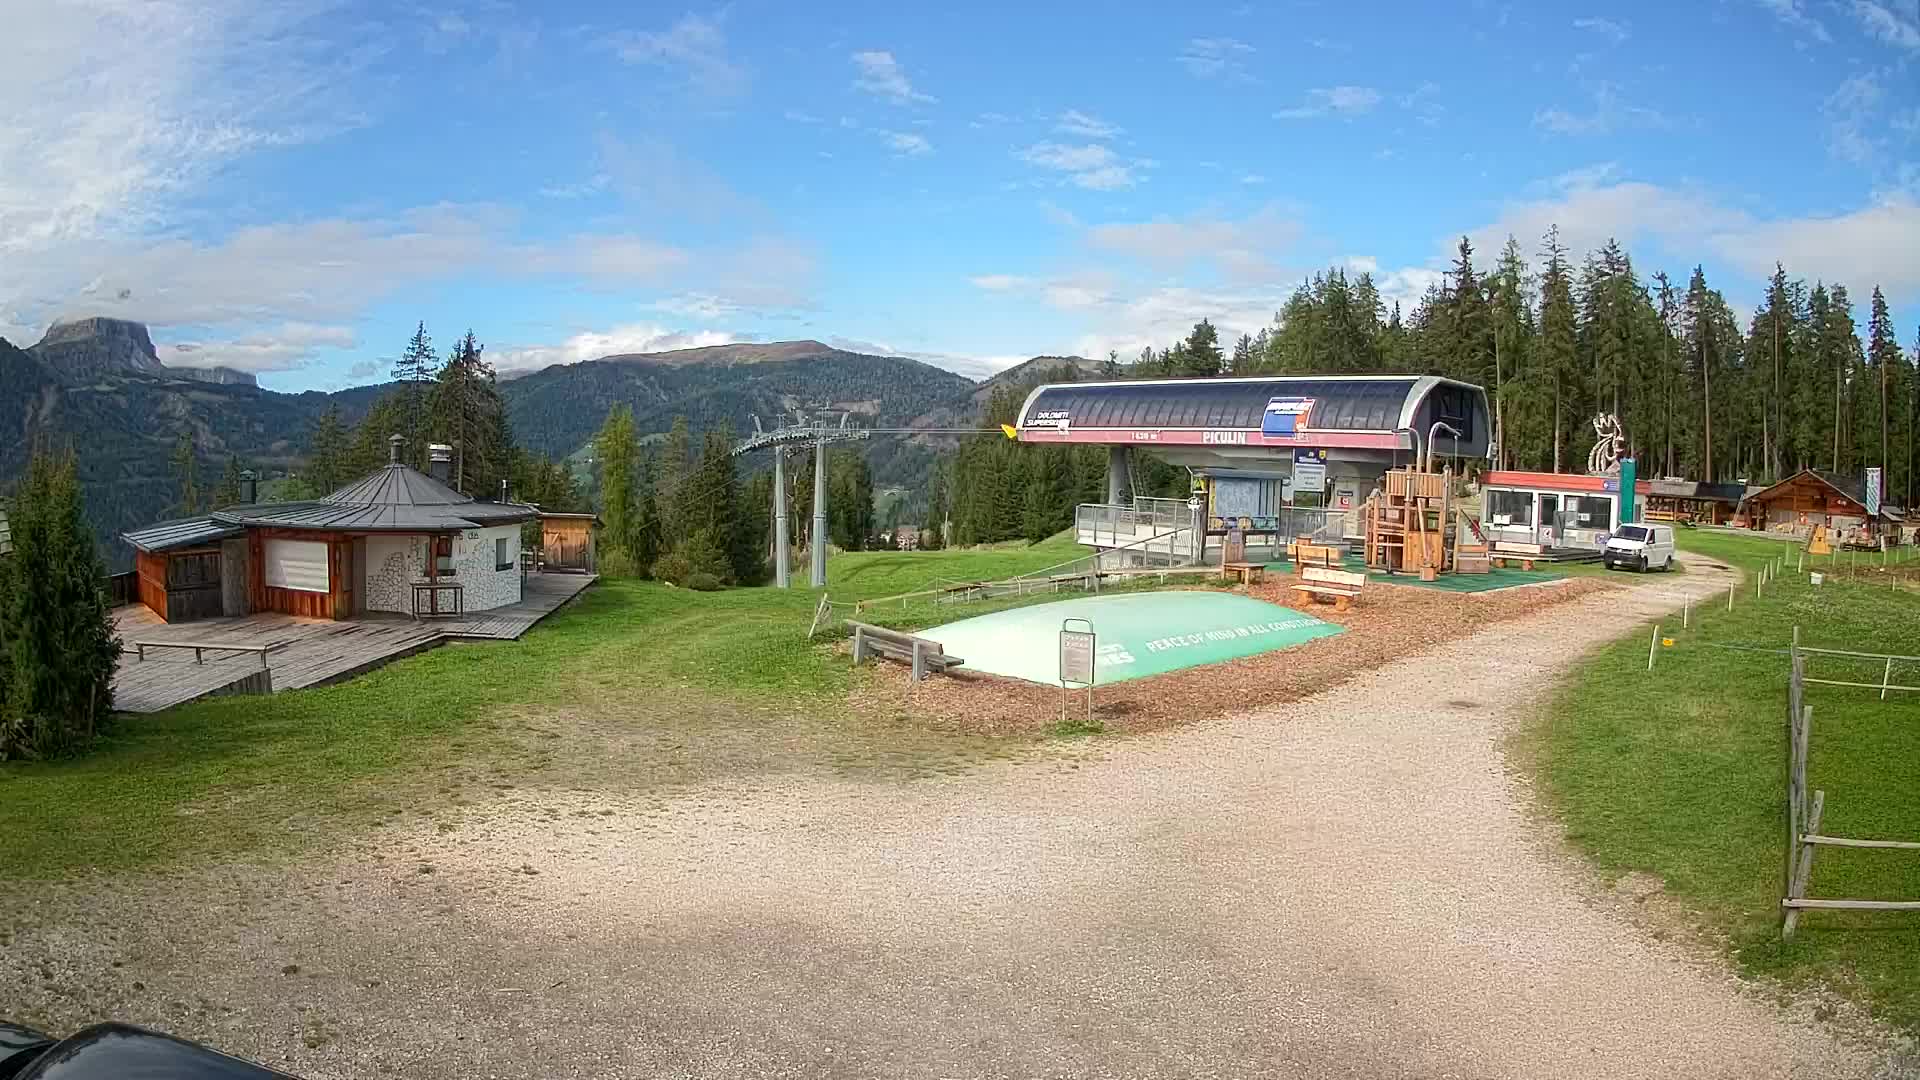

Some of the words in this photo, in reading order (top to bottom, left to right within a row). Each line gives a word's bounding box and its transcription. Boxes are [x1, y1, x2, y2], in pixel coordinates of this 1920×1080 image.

[1037, 411, 1069, 419] DOLOMITI
[1202, 431, 1247, 444] PICULIN
[1145, 636, 1190, 652] PEACE
[1188, 632, 1206, 645] OF
[1205, 629, 1236, 641] MIND
[1234, 627, 1250, 637] IN
[1248, 623, 1271, 634] ALL
